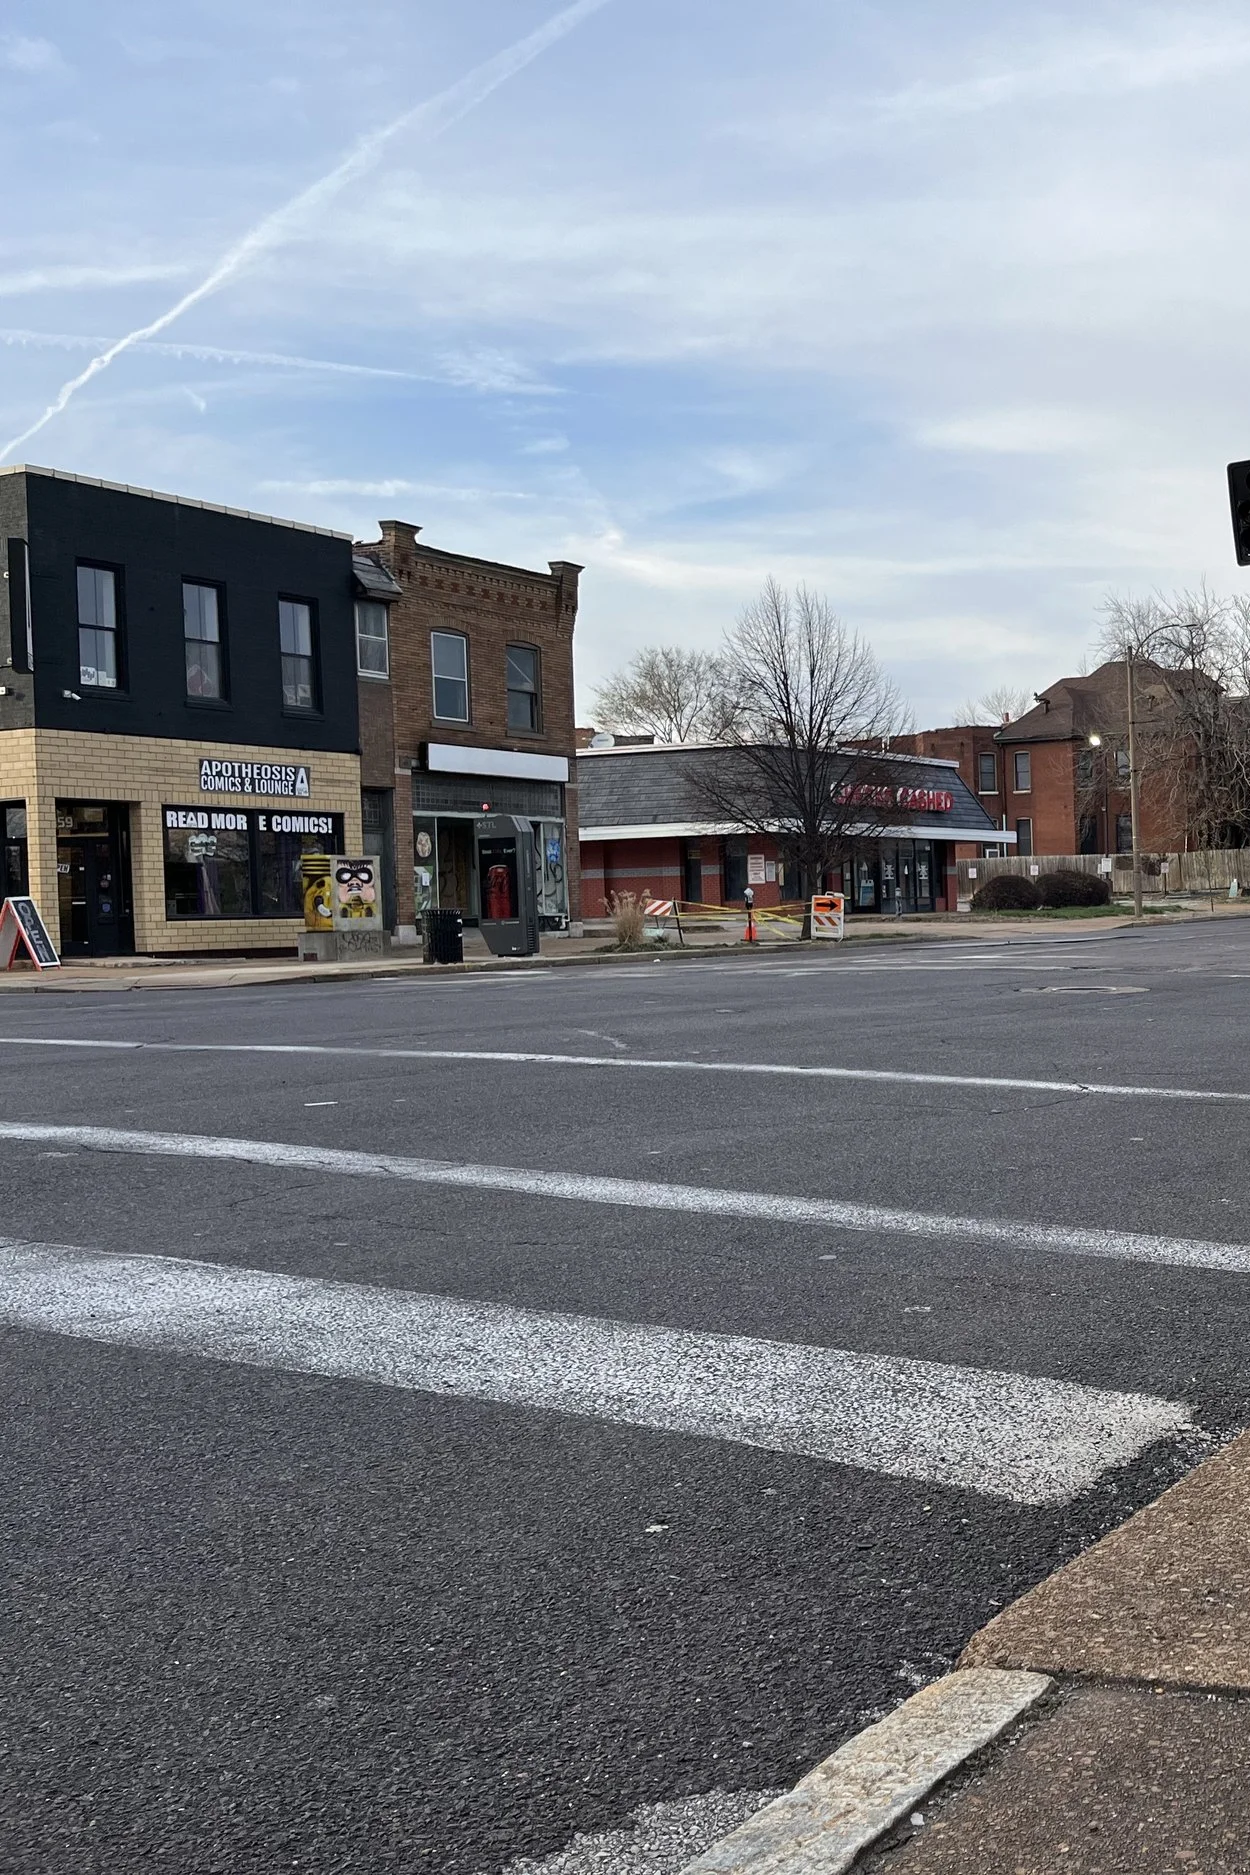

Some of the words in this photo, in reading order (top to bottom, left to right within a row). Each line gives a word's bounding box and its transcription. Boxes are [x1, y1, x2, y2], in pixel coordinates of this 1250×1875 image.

[200, 760, 296, 781] APOTHEOSIS
[201, 775, 242, 792] COMICS
[243, 777, 253, 793] &
[255, 778, 294, 796] LOUNGE
[166, 810, 209, 829] READ
[271, 815, 333, 834] COMICS!
